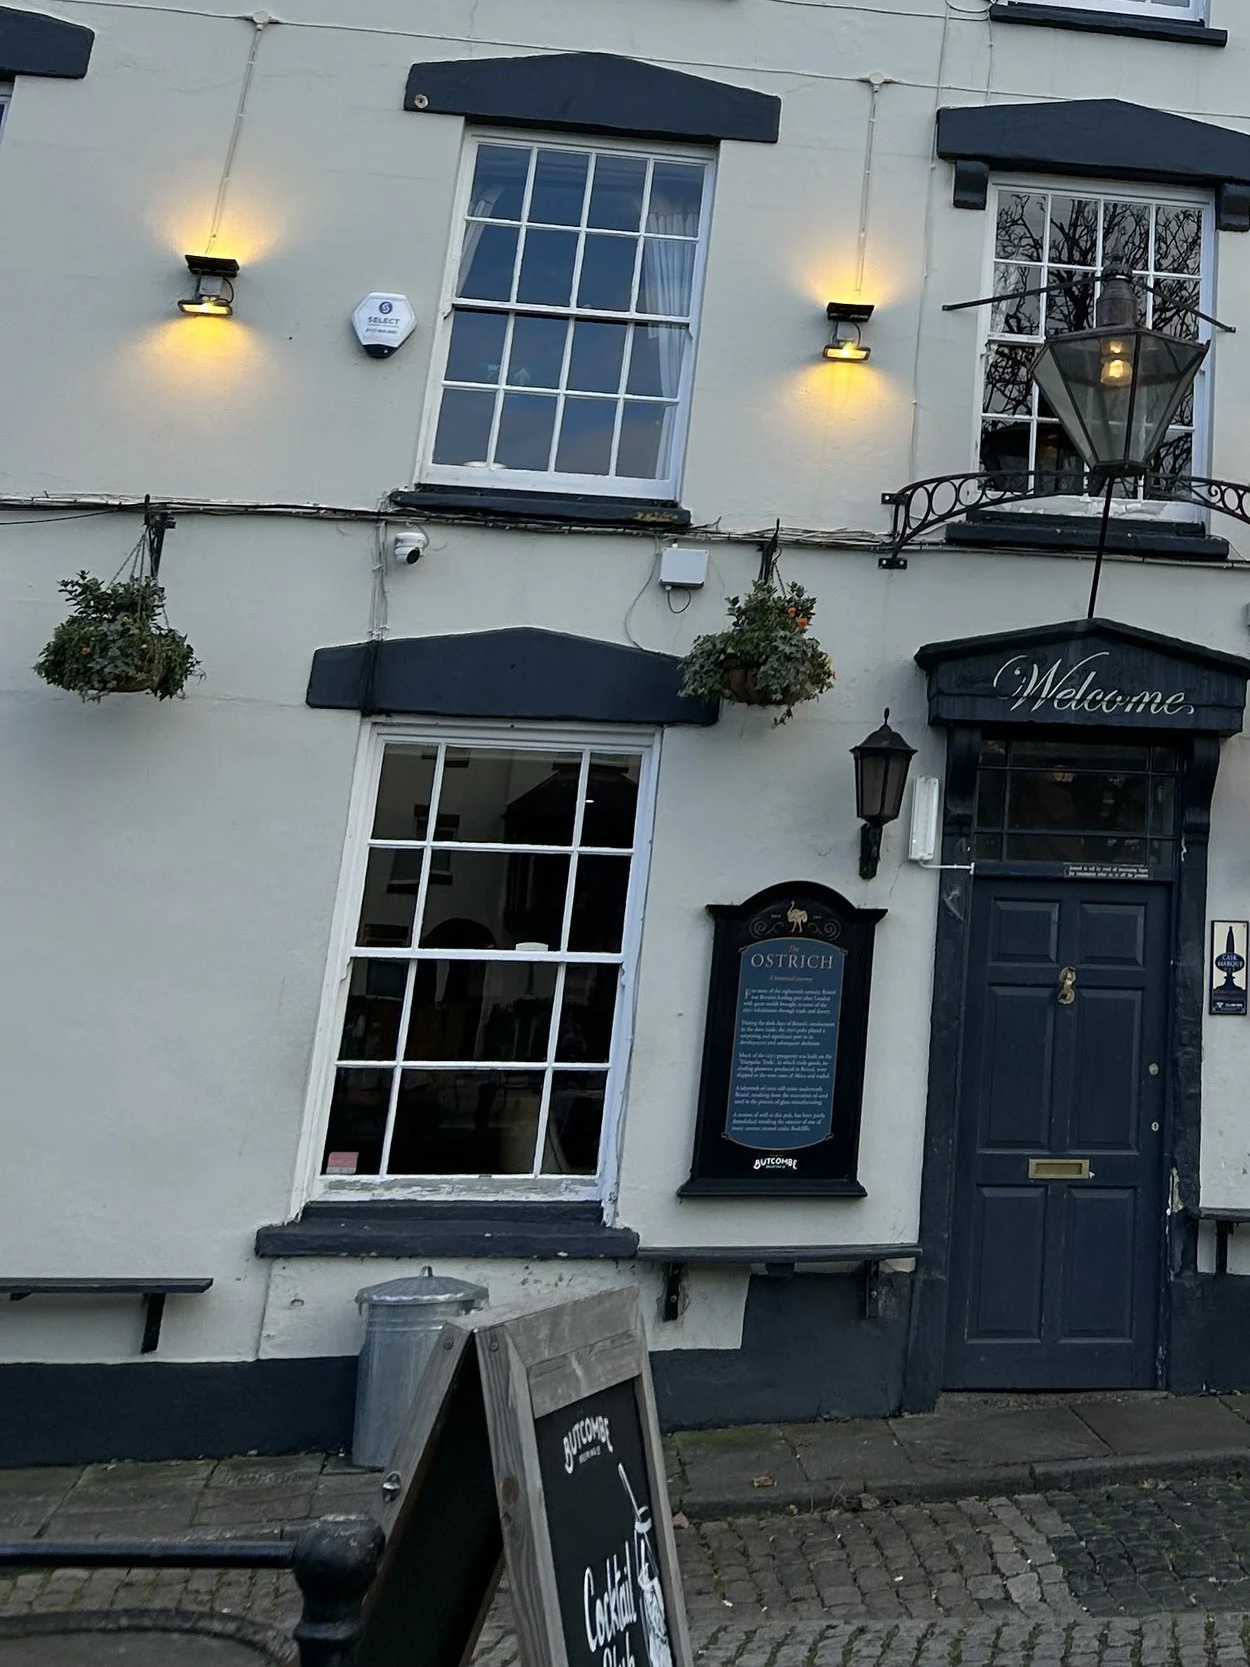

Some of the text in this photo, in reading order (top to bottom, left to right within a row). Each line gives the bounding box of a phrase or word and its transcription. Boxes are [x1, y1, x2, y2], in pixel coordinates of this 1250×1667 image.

[368, 316, 400, 324] SELECT
[992, 651, 1196, 715] Welcome
[751, 953, 833, 969] OSTRICH
[753, 1157, 798, 1170] BUTCOMBE
[563, 1415, 614, 1474] BUTCOMBE
[584, 1540, 637, 1653] Cocktail
